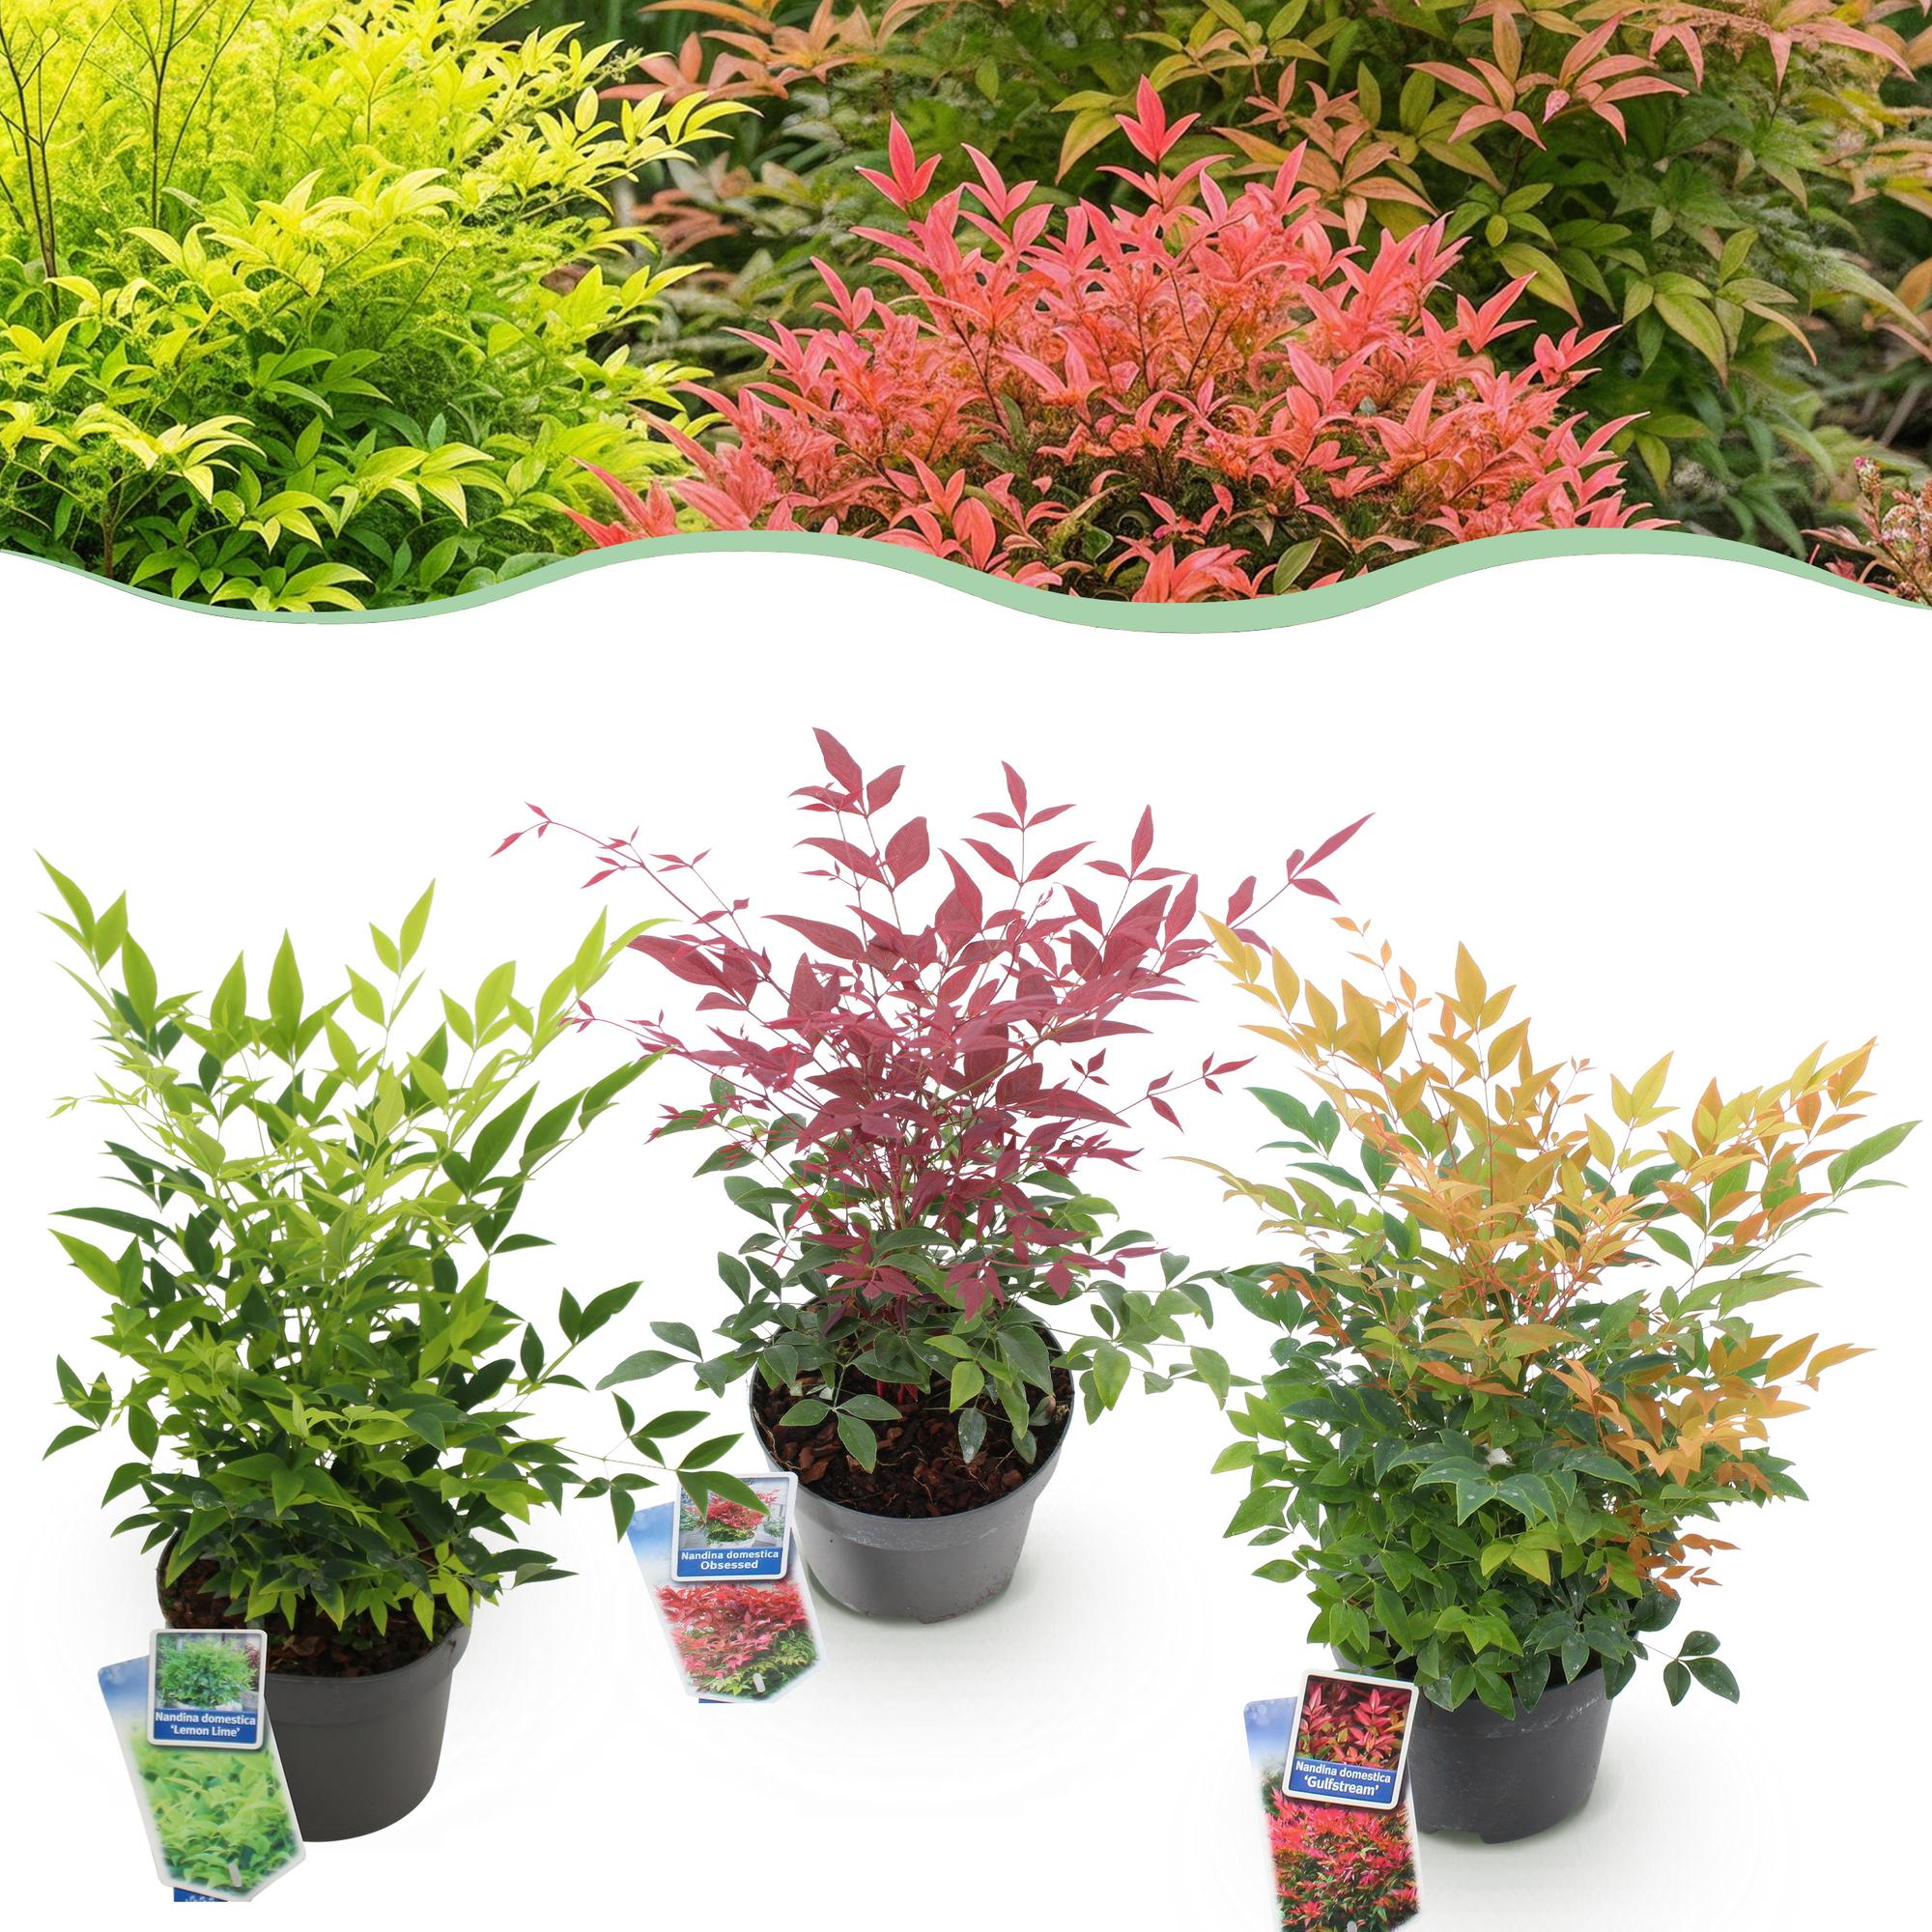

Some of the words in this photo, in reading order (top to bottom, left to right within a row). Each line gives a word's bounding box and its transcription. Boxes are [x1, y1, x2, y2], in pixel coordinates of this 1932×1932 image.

[681, 1550, 724, 1560] Nandina
[726, 1550, 780, 1559] domestica
[700, 1560, 758, 1570] Obsessed
[156, 1712, 199, 1722] Nandina
[201, 1714, 256, 1725] domestica
[1295, 1760, 1337, 1776] Nandina
[1339, 1767, 1391, 1783] domestica
[1304, 1775, 1379, 1796] ‘Gulfstream’
